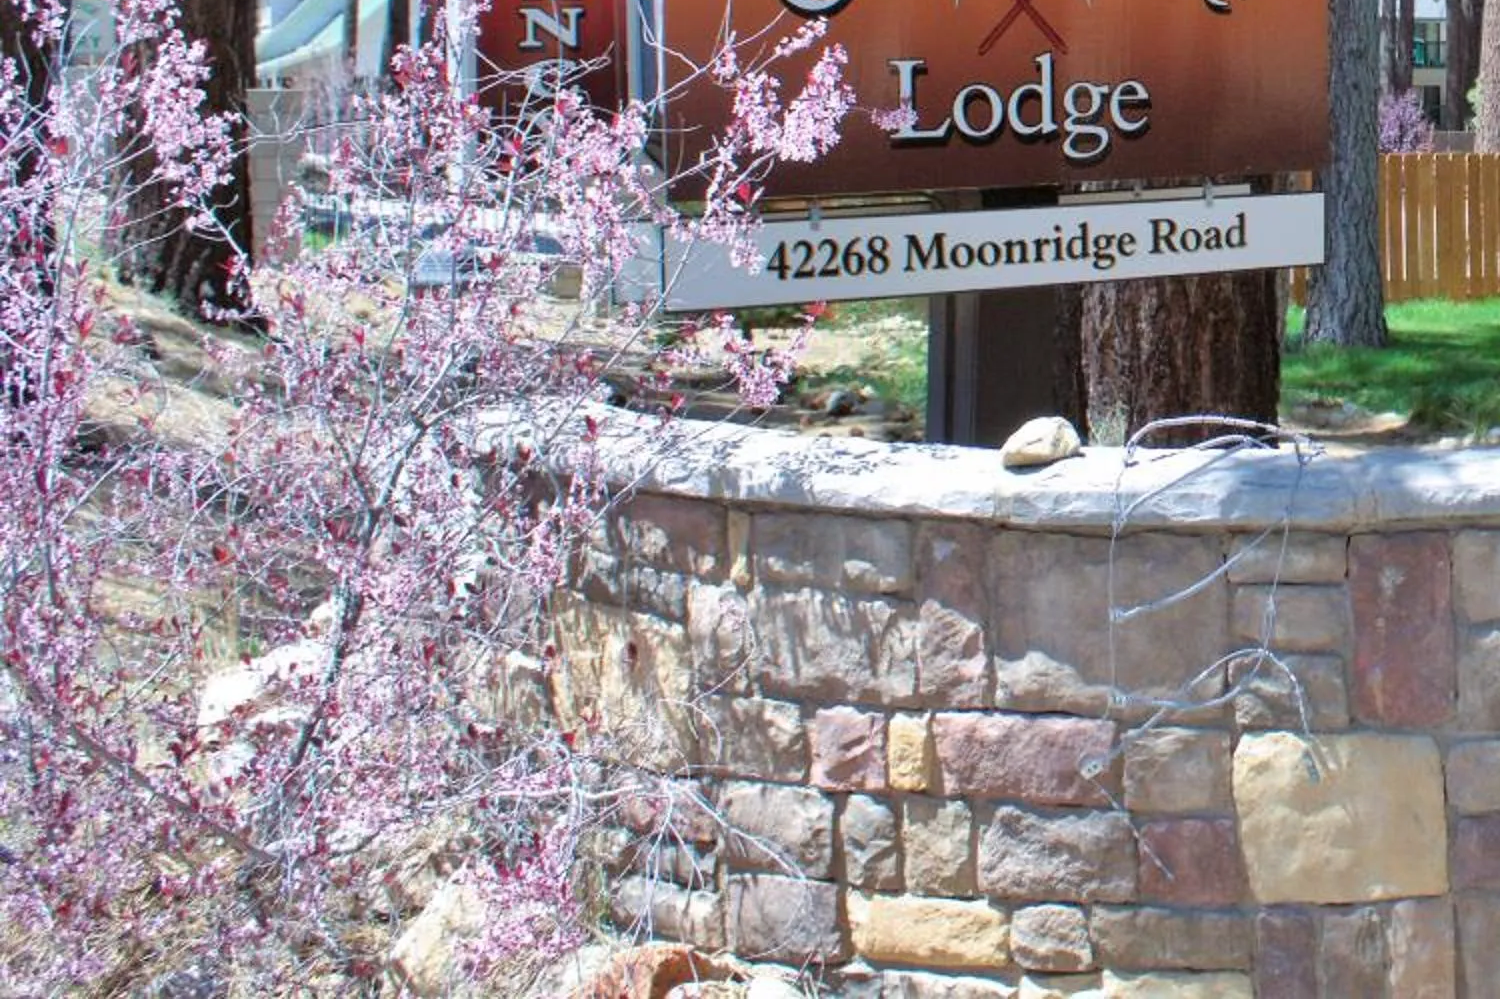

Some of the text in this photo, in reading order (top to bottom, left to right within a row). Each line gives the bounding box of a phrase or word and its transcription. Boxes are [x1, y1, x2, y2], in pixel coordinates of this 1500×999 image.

[888, 51, 1152, 163] Lodge
[766, 213, 1247, 280] 42268 Moonridge Road
